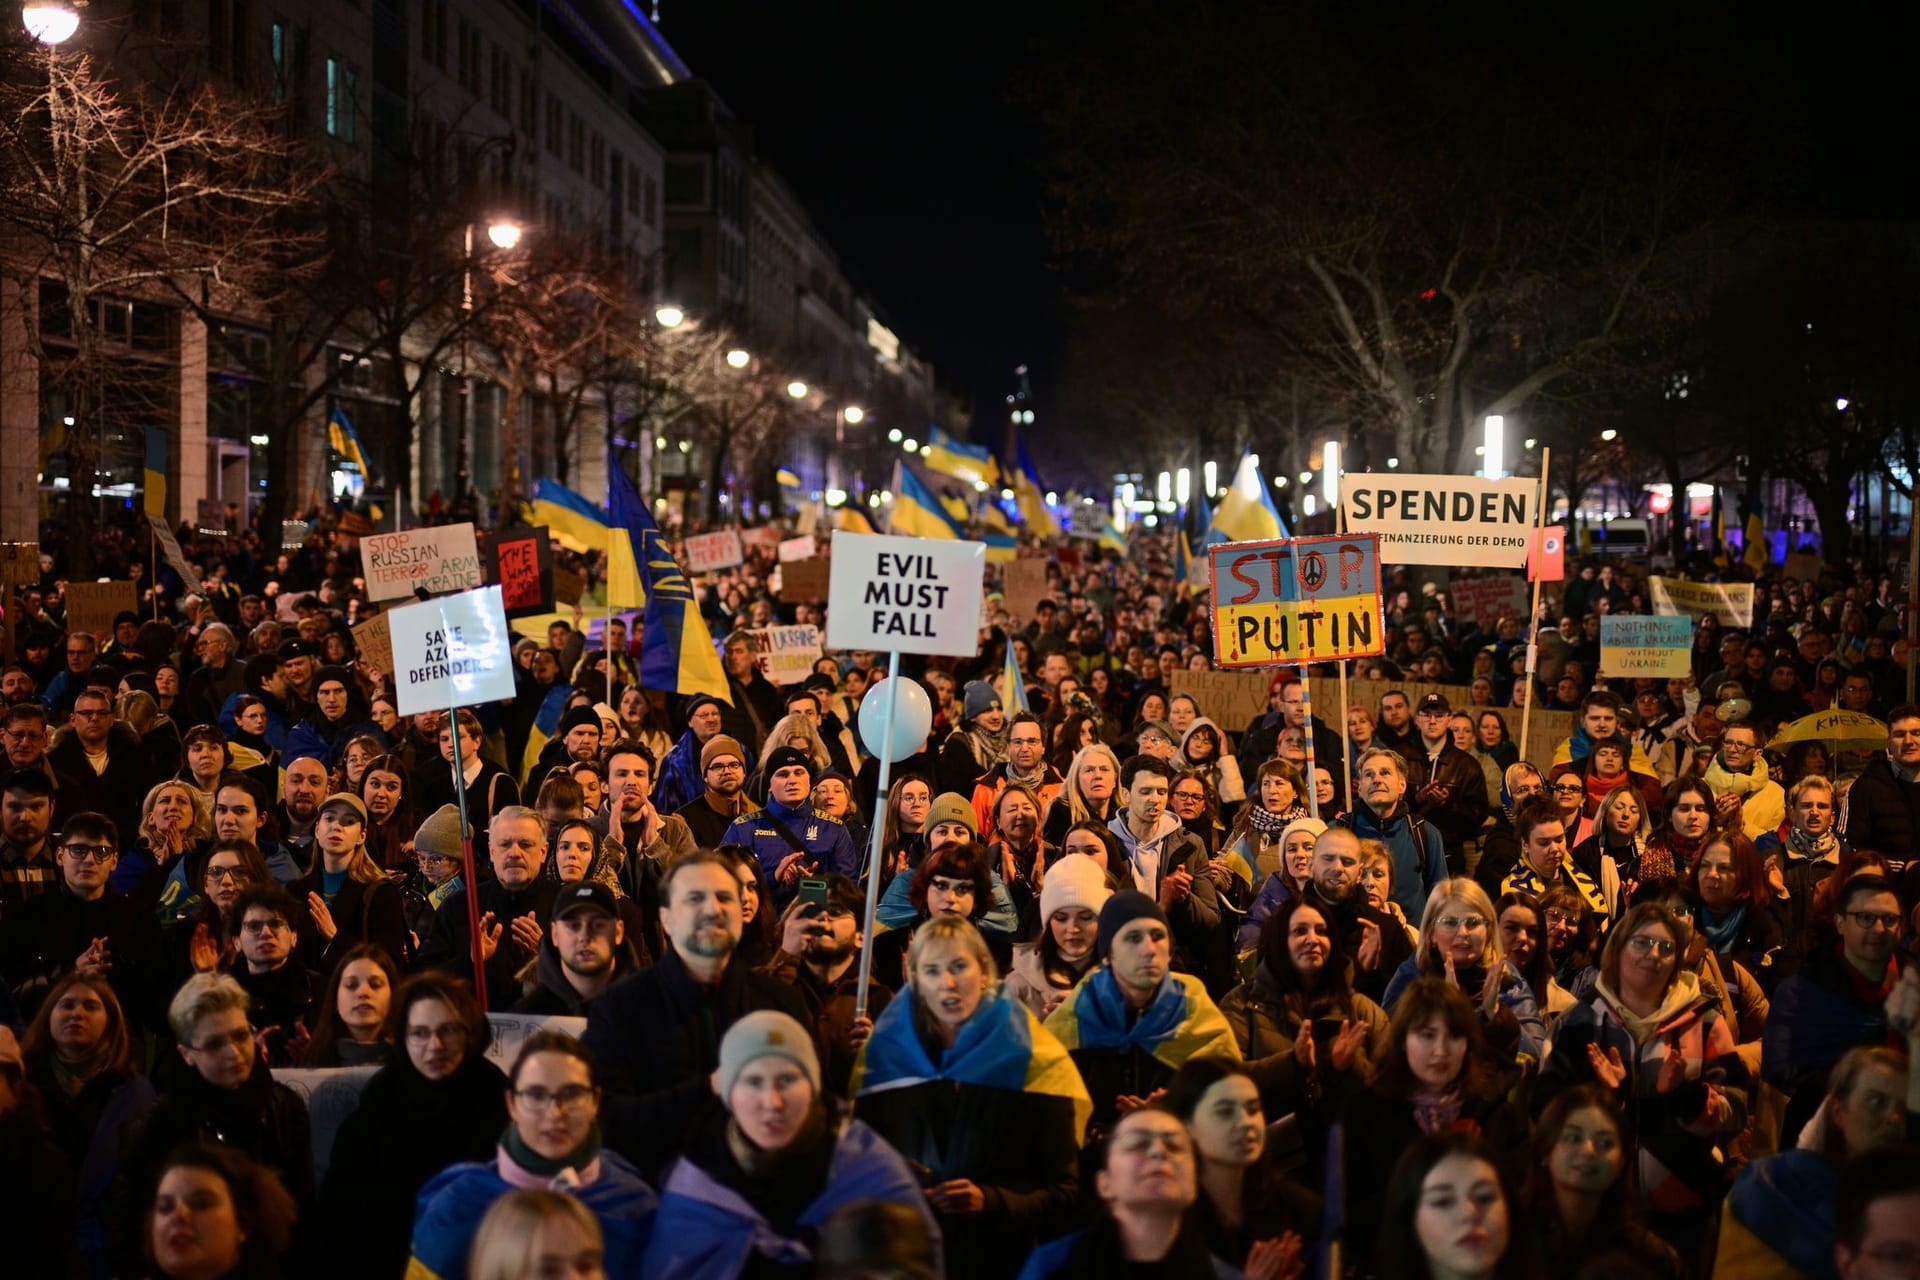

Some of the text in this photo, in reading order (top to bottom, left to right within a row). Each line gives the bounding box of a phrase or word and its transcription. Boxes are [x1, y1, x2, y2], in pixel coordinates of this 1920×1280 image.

[1352, 488, 1527, 524] SPENDEN
[368, 533, 409, 553] STOP
[1378, 533, 1525, 548] FINANZIERUNG DER DEMO
[371, 544, 439, 569] RUSSIAN
[440, 556, 480, 574] ARM
[501, 544, 532, 568] THE
[877, 552, 938, 580] EVIL
[374, 563, 430, 584] TERROR
[1230, 543, 1365, 604] STOP
[864, 580, 949, 609] MUST
[872, 610, 936, 638] FALL
[1238, 611, 1371, 654] PUTIN
[1615, 622, 1672, 632] NOTHING
[1608, 634, 1690, 645] ABOUT UKRAINE
[1619, 658, 1668, 669] UKRAINE
[1626, 649, 1674, 657] WITHOUT
[409, 656, 491, 684] DEFENDER
